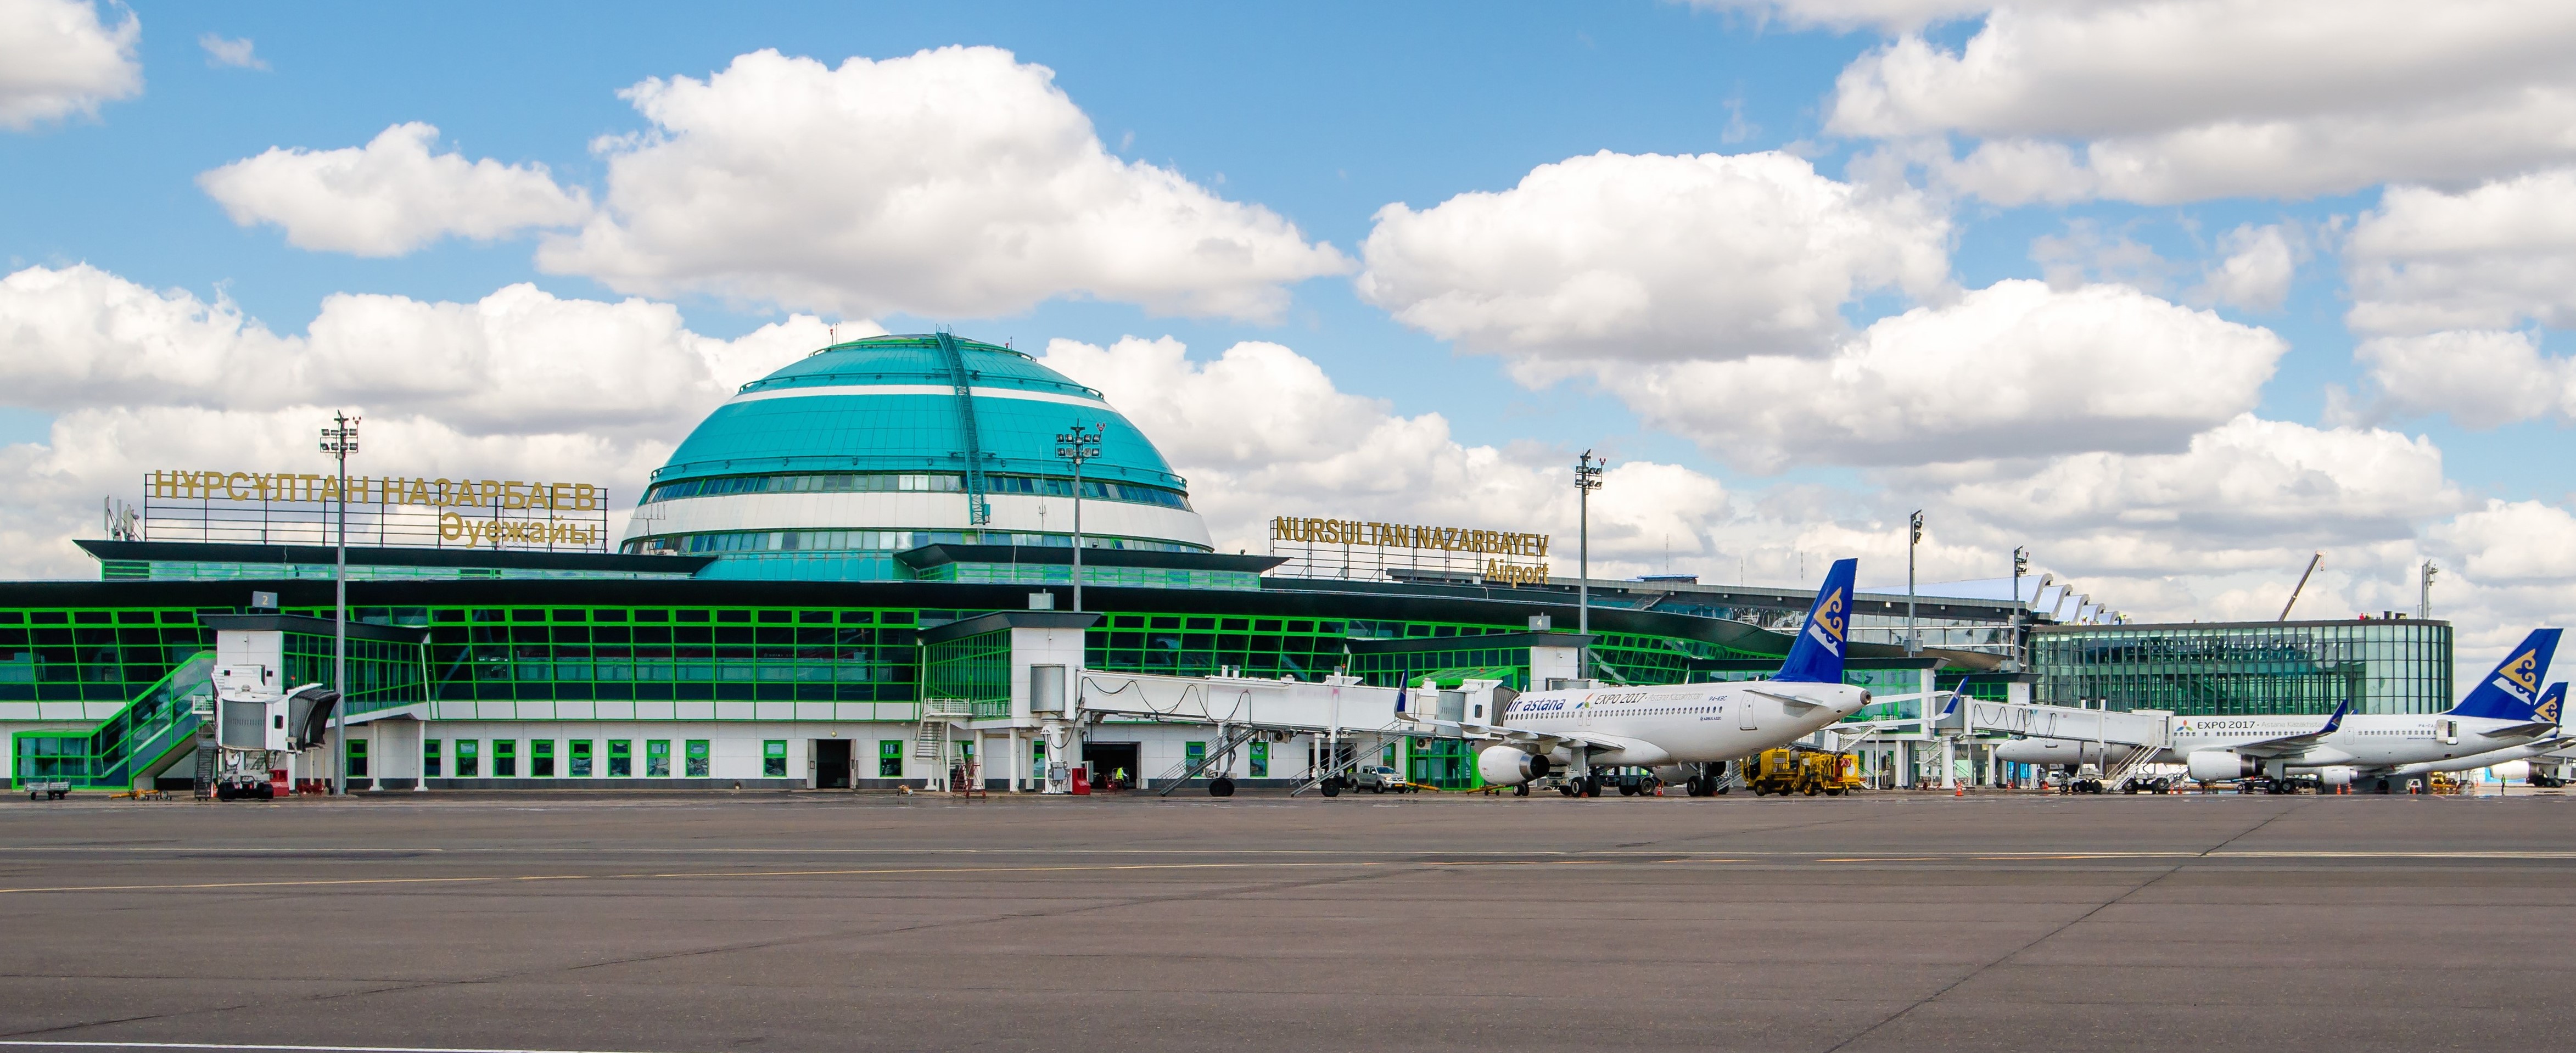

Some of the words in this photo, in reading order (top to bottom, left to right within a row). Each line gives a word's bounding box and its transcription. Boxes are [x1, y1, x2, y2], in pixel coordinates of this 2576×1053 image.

[155, 470, 368, 504] НҰРСҰЛТАН
[383, 476, 597, 511] НАЗАРБАЕВ
[440, 512, 596, 548] Әуежайы
[1276, 516, 1409, 548] NURSULTAN
[1416, 525, 1550, 557] NAZARBAYEV
[1485, 558, 1549, 589] Airport
[262, 595, 268, 605] 2
[1537, 618, 1542, 627] 4
[1523, 698, 1566, 712] astana
[1594, 694, 1621, 705] EXPO
[1620, 693, 1647, 704] 2017
